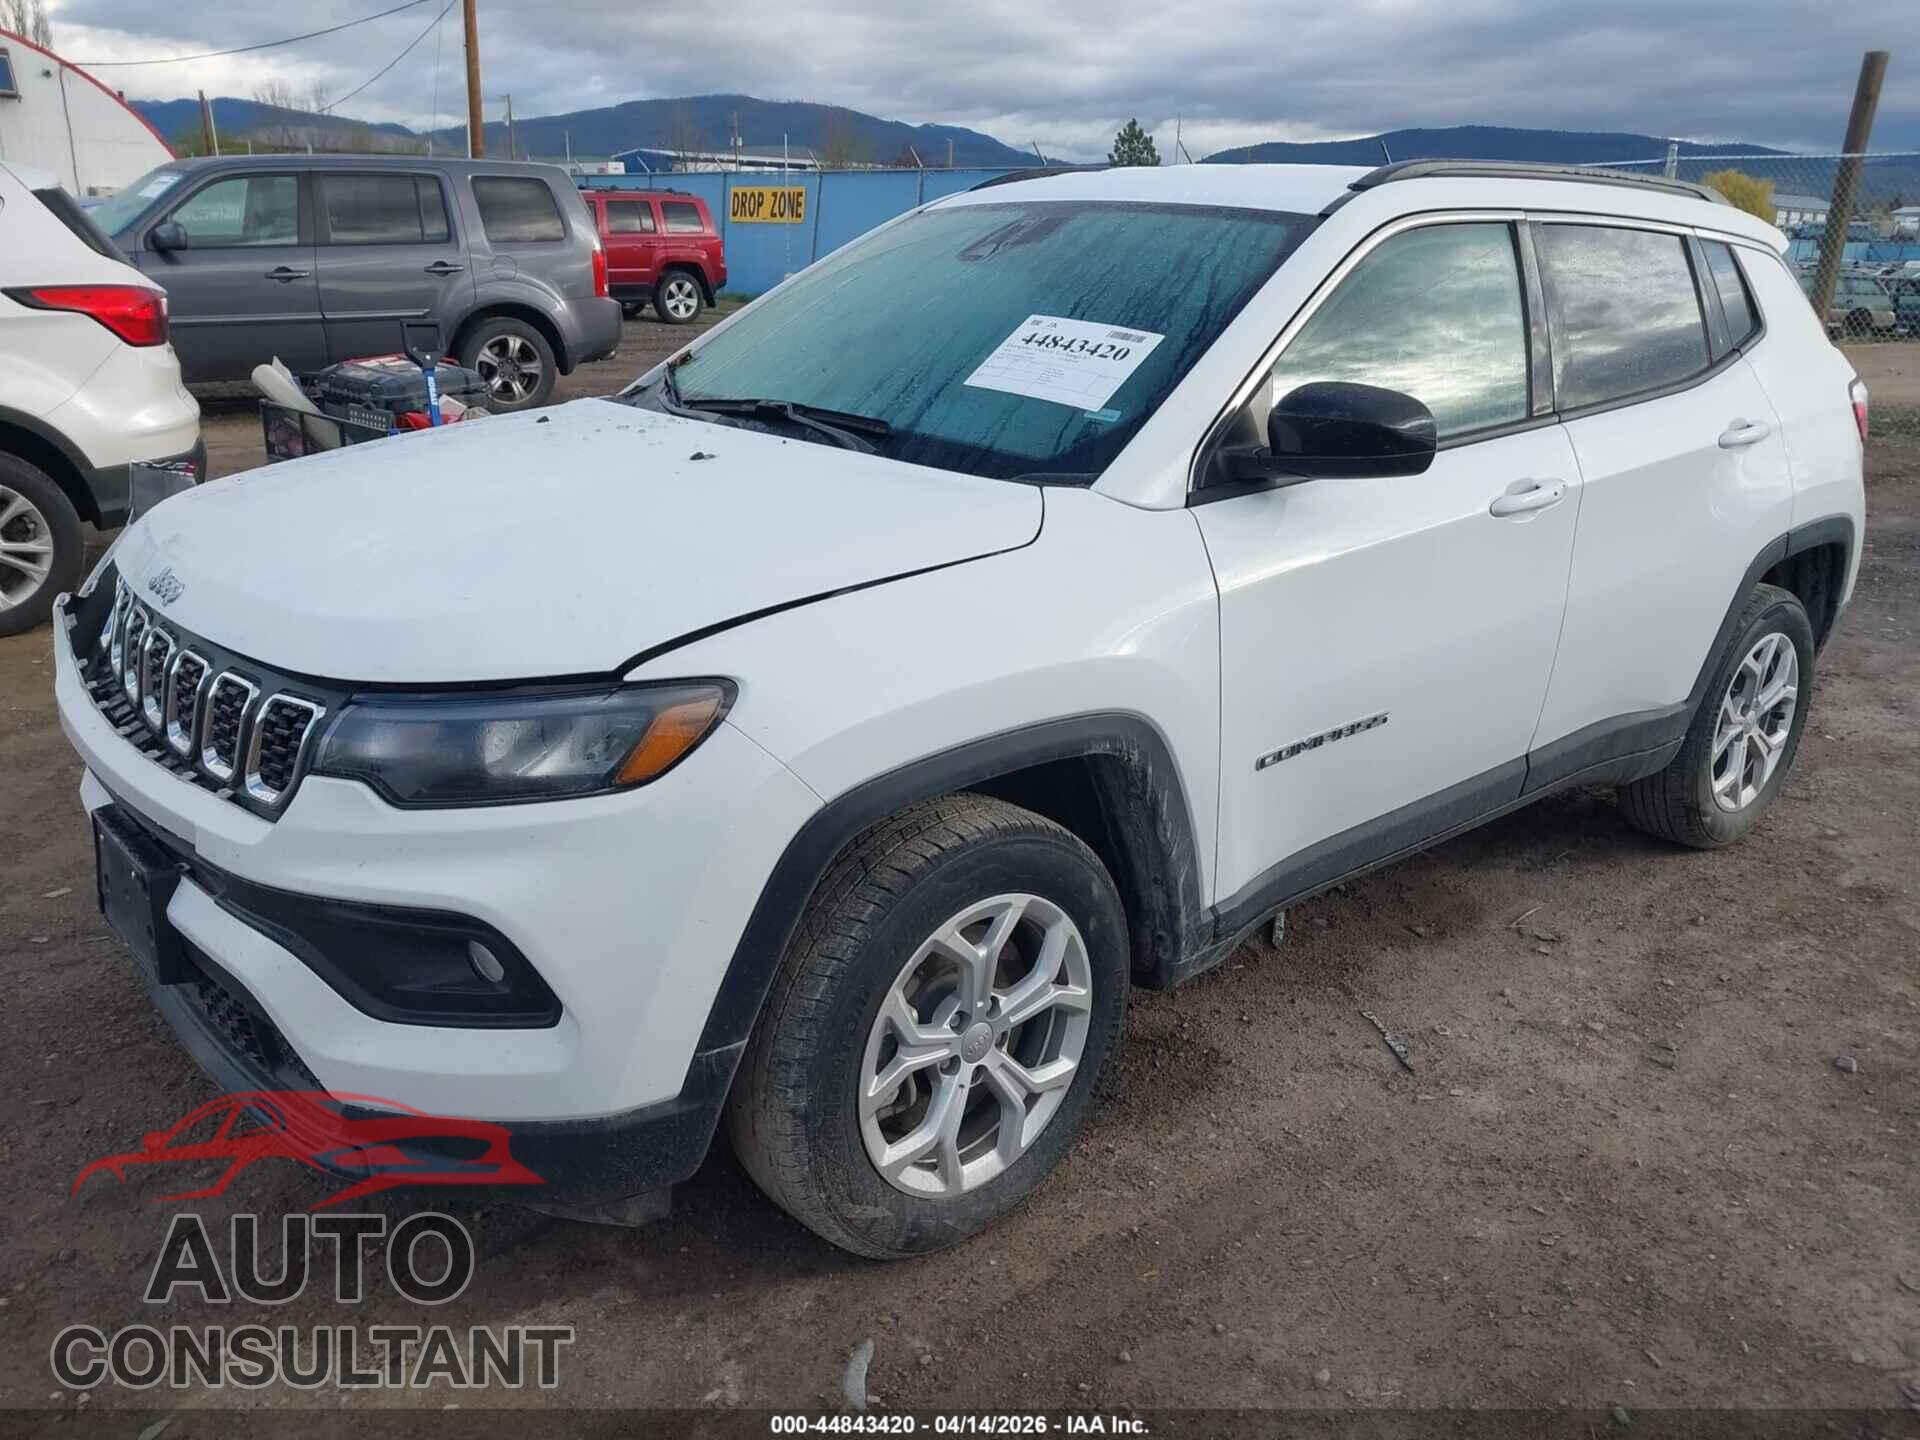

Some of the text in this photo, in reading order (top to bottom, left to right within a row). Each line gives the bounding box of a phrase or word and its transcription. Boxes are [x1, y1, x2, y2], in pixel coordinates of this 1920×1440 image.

[732, 191, 803, 218] DROP ZONE
[1021, 332, 1131, 362] 44843420
[1255, 712, 1390, 771] COMPASS
